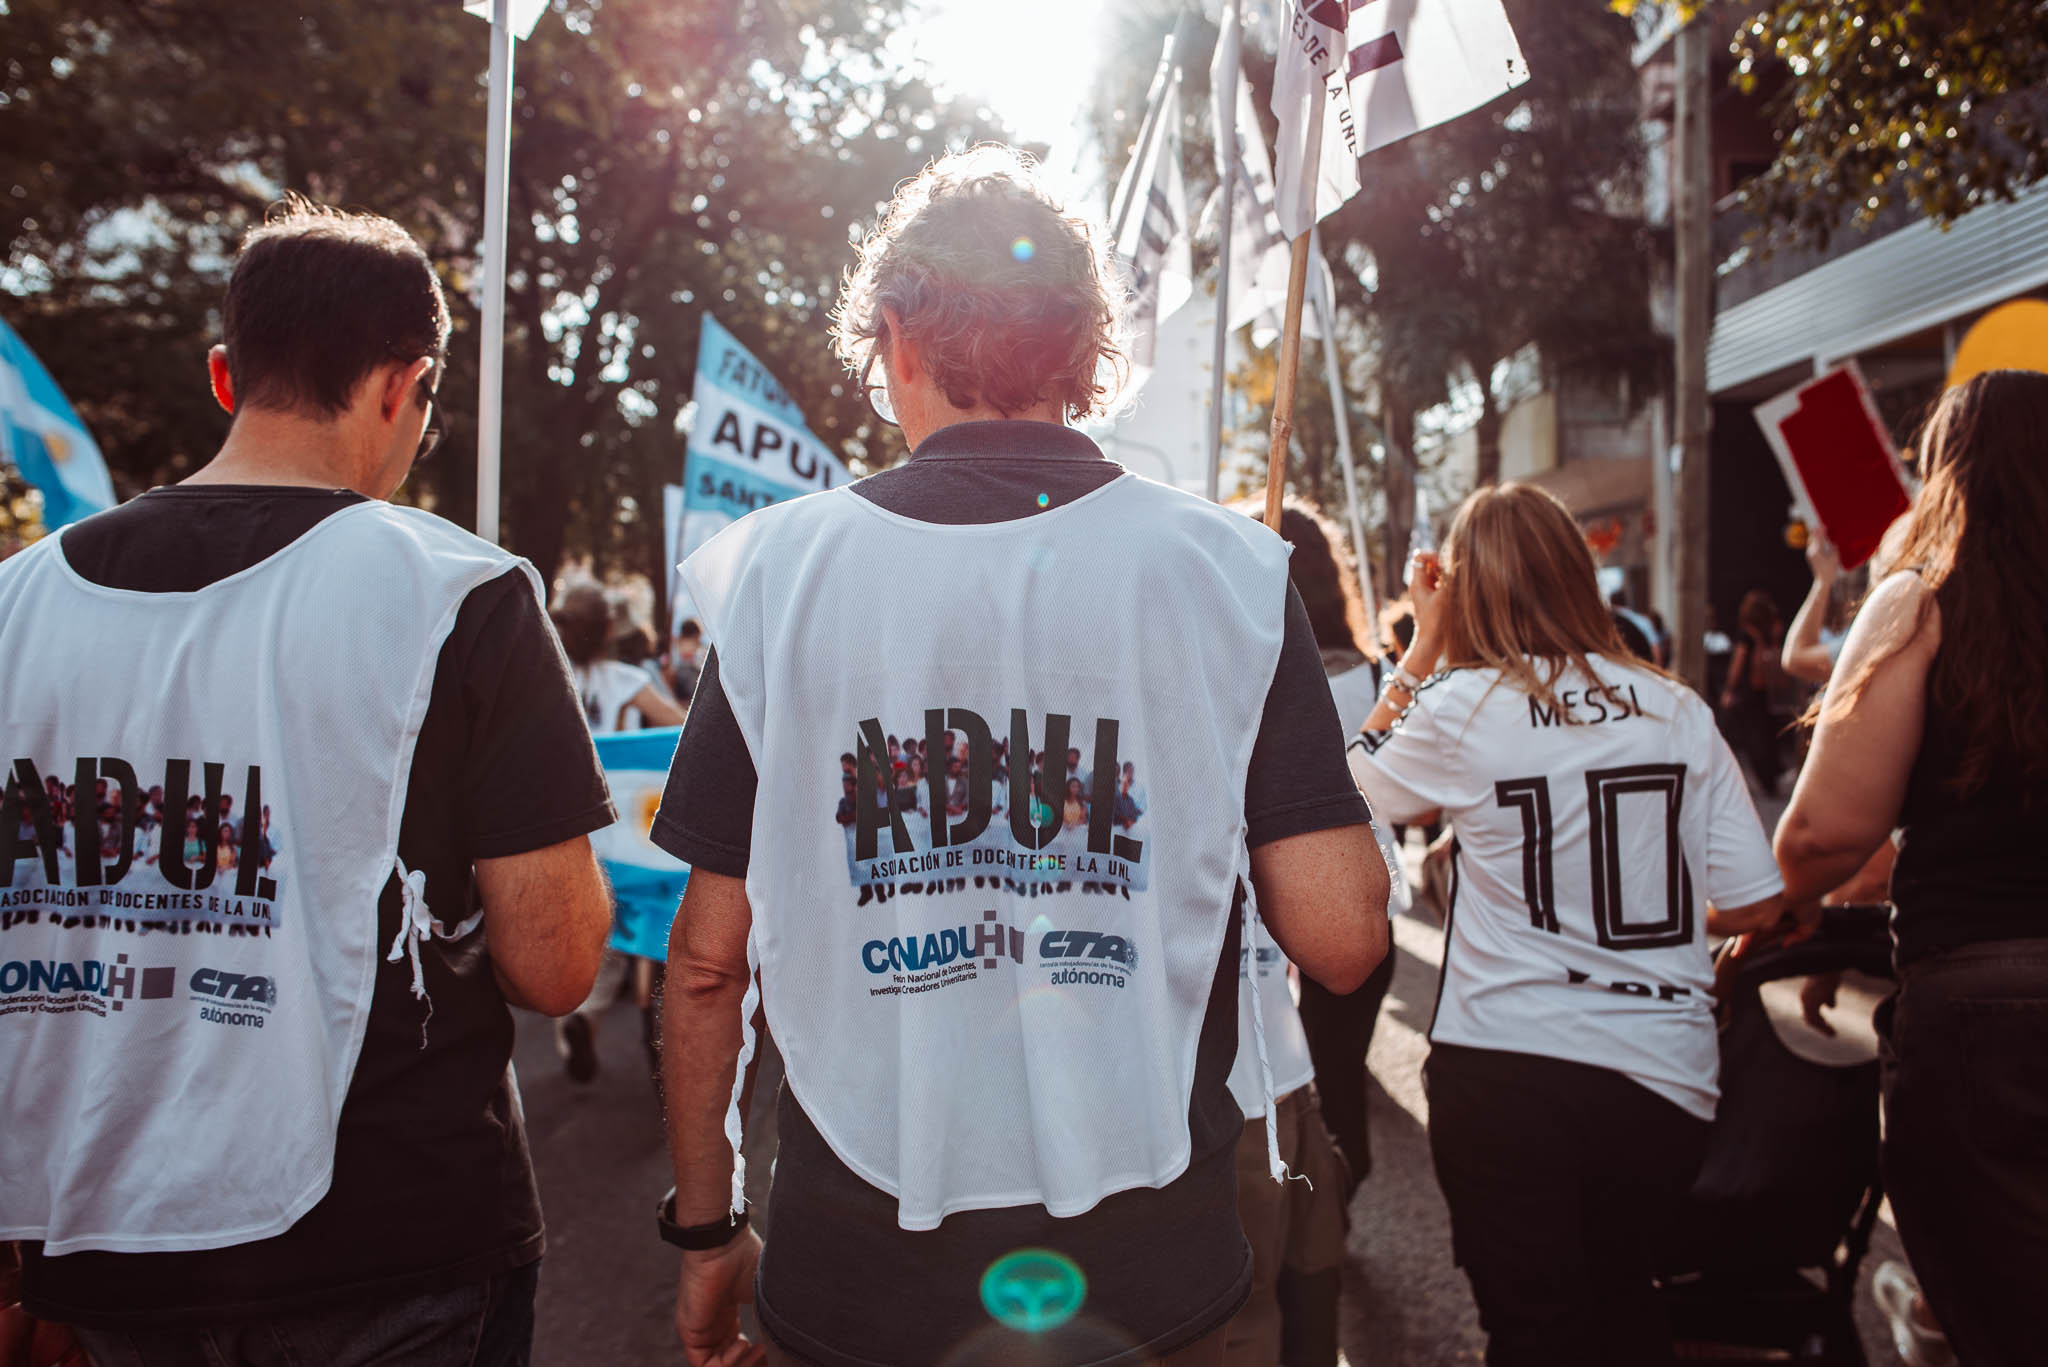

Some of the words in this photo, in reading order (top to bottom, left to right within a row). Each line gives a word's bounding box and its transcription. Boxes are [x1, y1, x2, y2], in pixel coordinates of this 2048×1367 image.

[1303, 33, 1329, 66] DE
[1339, 108, 1357, 154] UNL
[1529, 684, 1642, 728] MESSI
[856, 708, 1143, 863] ADUL
[0, 757, 277, 902] ADUL
[946, 850, 964, 868] DE
[973, 848, 1043, 871] DOCENTES
[1048, 854, 1067, 871] DE
[1076, 856, 1098, 874] LA
[1108, 860, 1131, 882] UNL
[1495, 763, 1694, 951] 10
[1, 888, 89, 907] ASOCIACIÓN
[100, 889, 113, 905] DE
[115, 892, 203, 910] DOCENTES
[224, 899, 244, 916] LA
[252, 902, 271, 920] UN
[1039, 930, 1127, 964] CTA
[189, 968, 269, 1004] CTA
[902, 981, 940, 994] Creadores
[907, 969, 941, 983] Nacional
[942, 968, 948, 976] de
[1051, 968, 1125, 988] autónoma
[200, 1006, 264, 1028] autónoma
